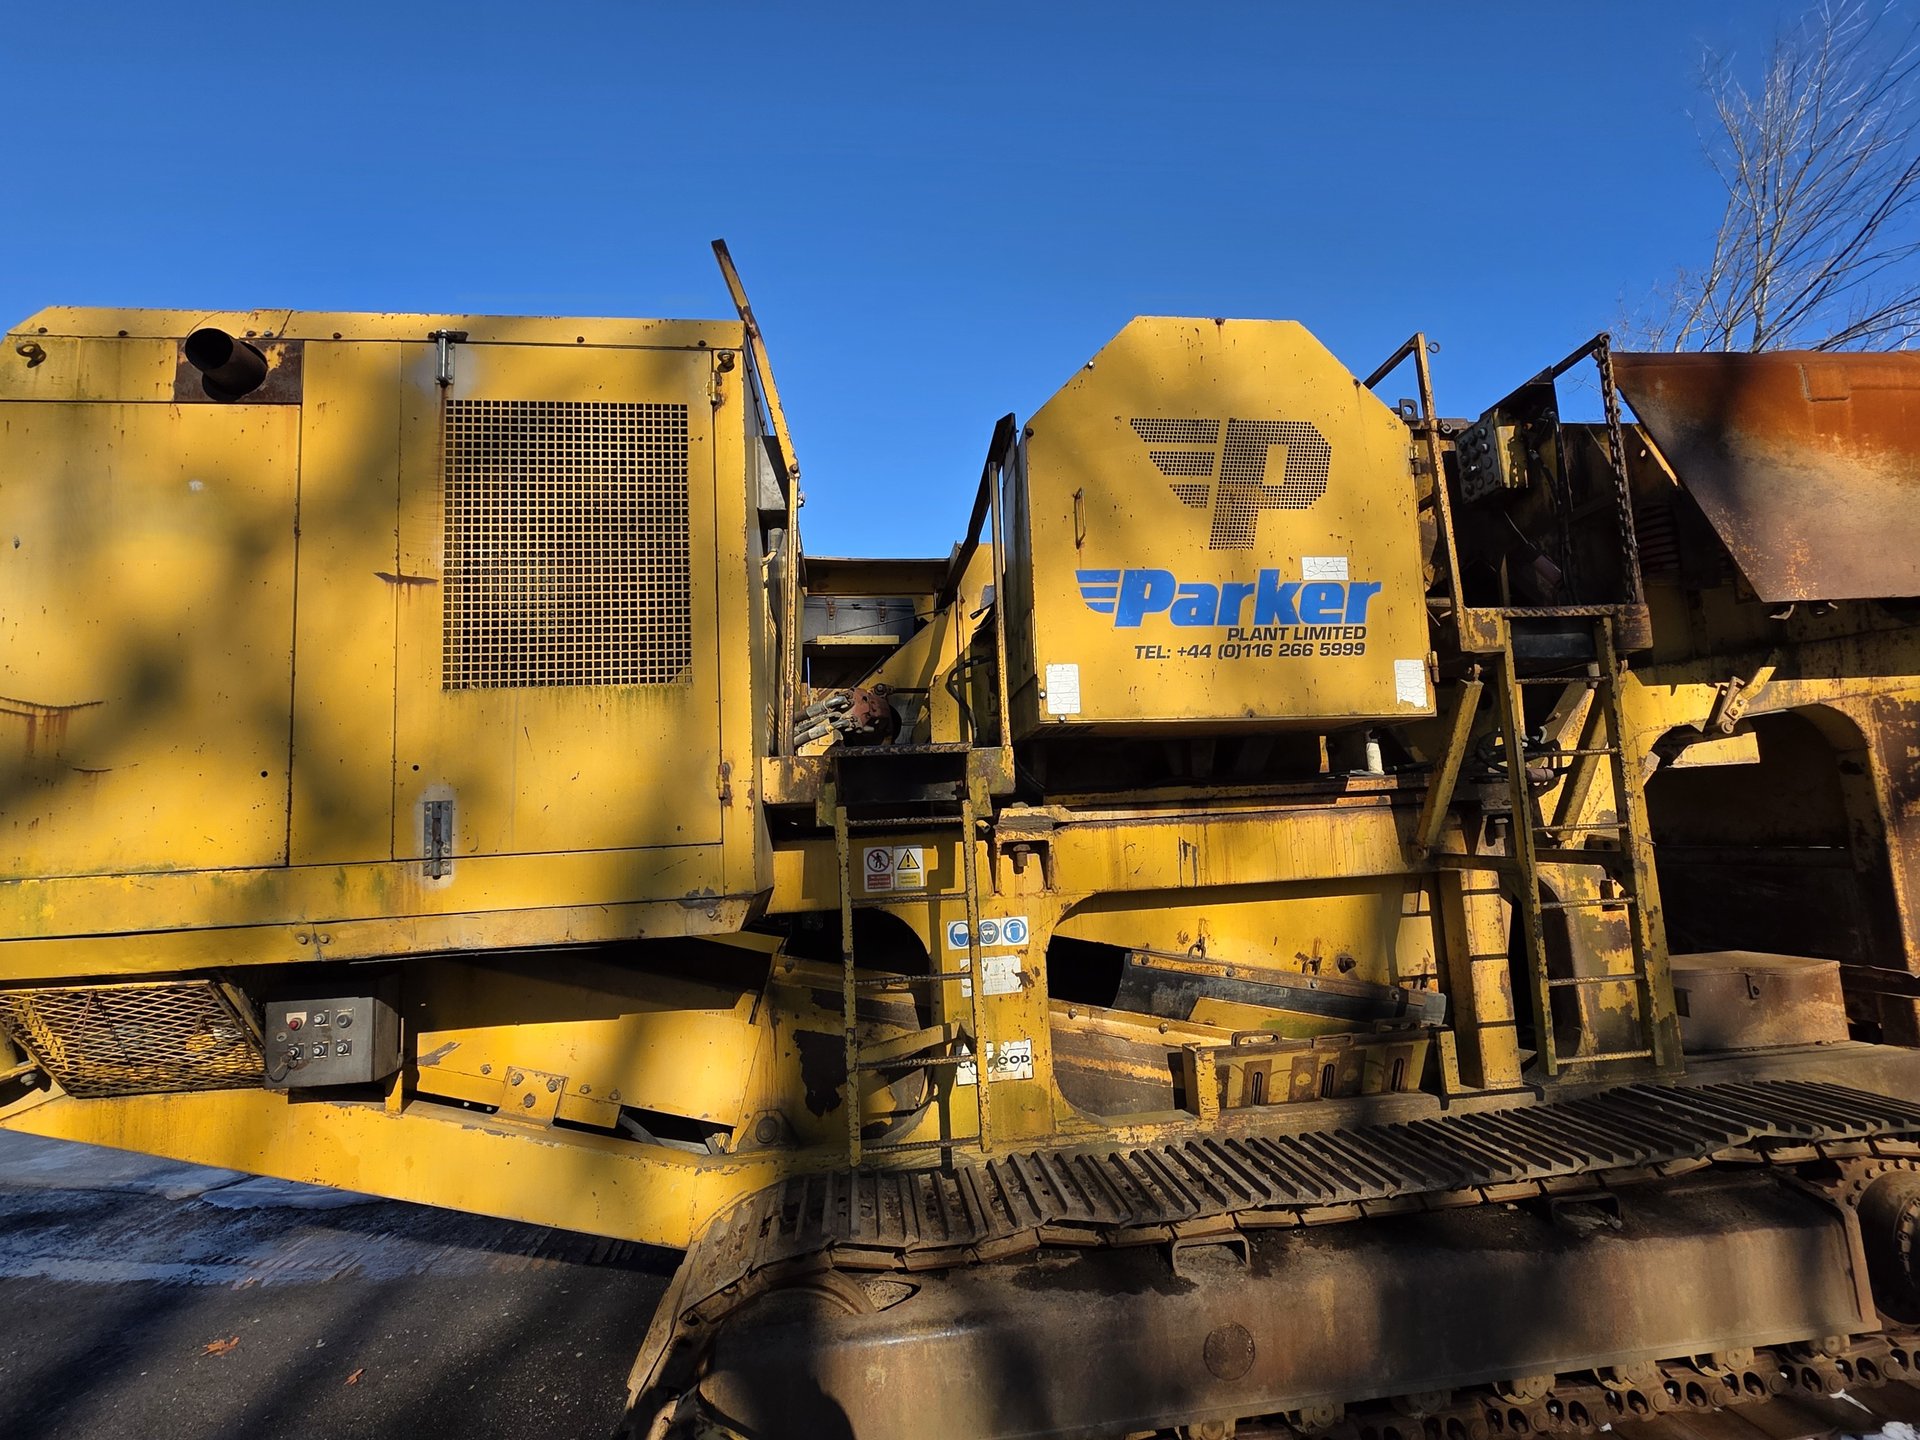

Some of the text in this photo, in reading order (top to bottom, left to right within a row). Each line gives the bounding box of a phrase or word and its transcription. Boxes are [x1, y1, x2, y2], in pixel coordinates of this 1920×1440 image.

[1114, 569, 1382, 627] Parker
[1227, 626, 1367, 641] PLANT LIMITED
[1135, 642, 1366, 660] TEL: +44 (0)116 266 5999
